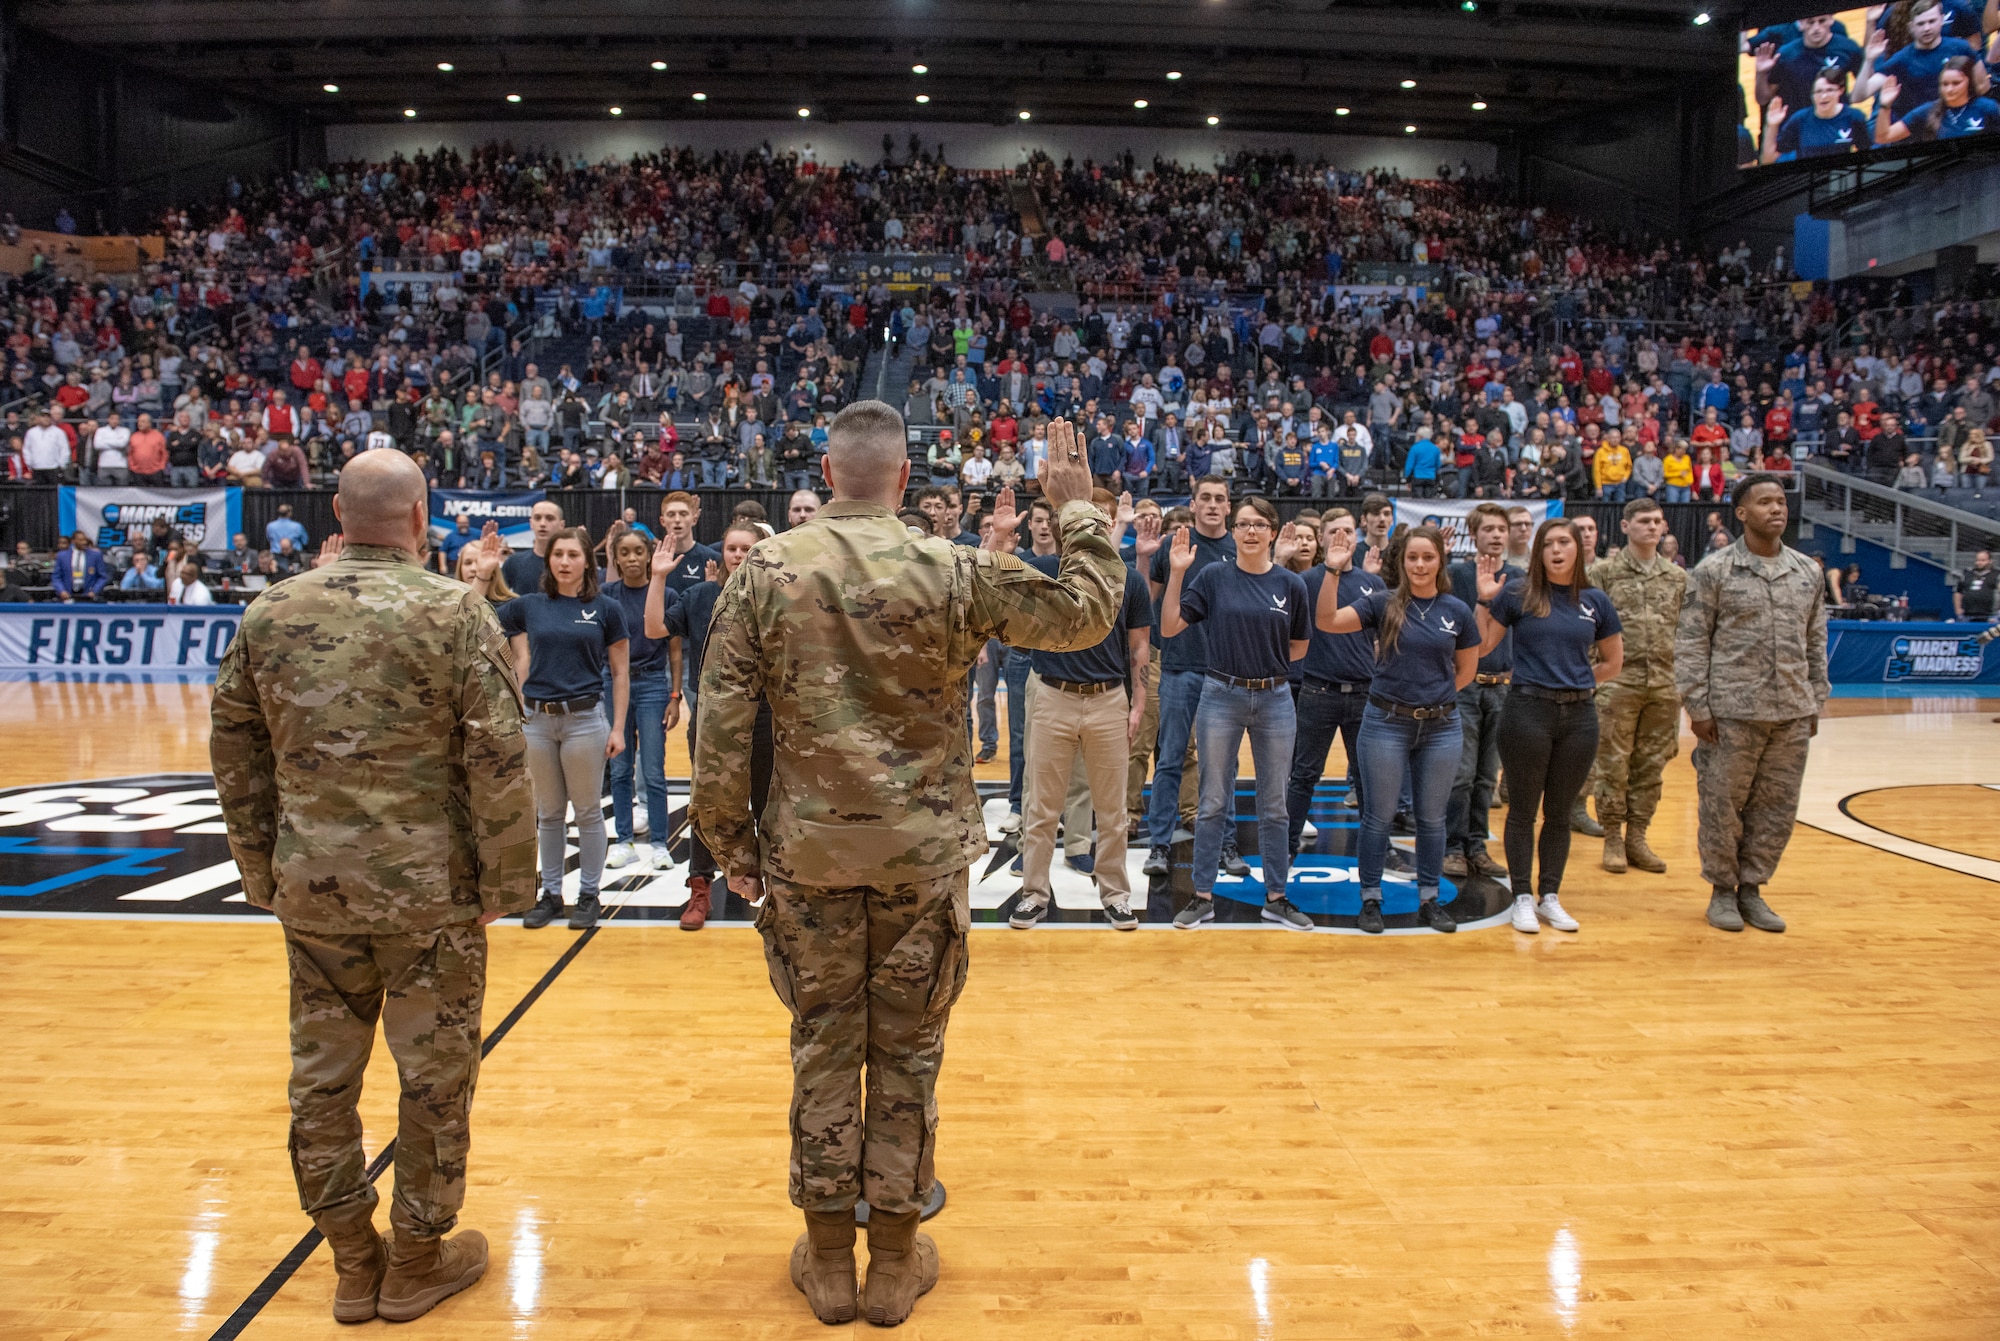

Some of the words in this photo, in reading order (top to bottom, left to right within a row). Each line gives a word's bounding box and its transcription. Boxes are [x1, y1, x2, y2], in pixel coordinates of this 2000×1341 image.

[119, 506, 178, 523] MARCH
[443, 500, 532, 516] NCAA.com
[127, 524, 205, 542] MAESS
[28, 619, 164, 664] FIRST
[177, 619, 238, 665] FO
[1908, 640, 1959, 656] MARCH
[1912, 656, 1981, 672] MADNESS
